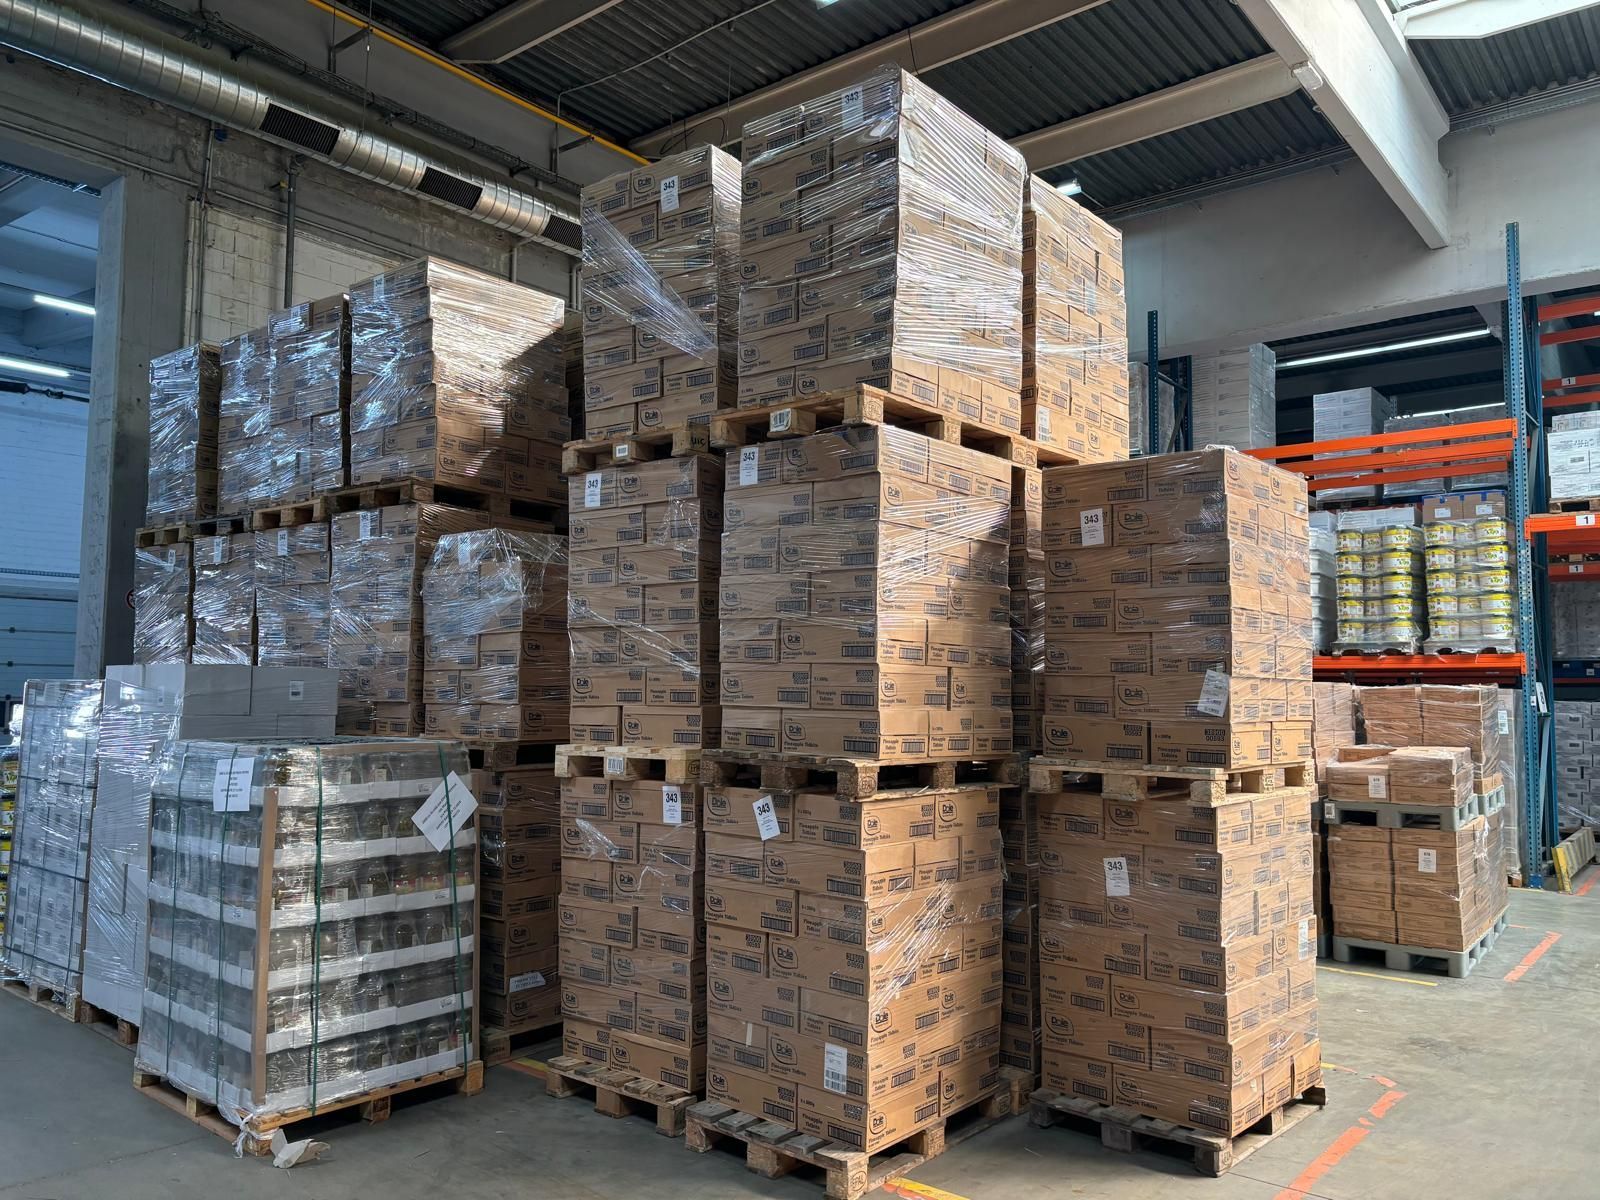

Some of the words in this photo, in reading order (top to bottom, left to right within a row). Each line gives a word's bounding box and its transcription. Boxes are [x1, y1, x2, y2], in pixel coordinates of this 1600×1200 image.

[844, 92, 859, 104] 343
[664, 180, 675, 191] 343
[802, 380, 815, 388] Dole
[645, 411, 658, 420] Dole
[743, 452, 755, 462] 343
[588, 480, 598, 488] 343
[888, 486, 900, 498] Dole
[1084, 514, 1099, 524] 343
[1125, 513, 1143, 522] Dole
[1584, 516, 1589, 524] 1
[1124, 606, 1139, 614] Dole
[1050, 651, 1064, 659] Dole
[577, 678, 588, 686] Dole
[727, 679, 739, 687] Dole
[884, 682, 894, 690] Dole
[1124, 689, 1143, 698] Dole
[788, 726, 802, 734] Dole
[1051, 729, 1068, 738] Dole
[666, 793, 678, 803] 343
[712, 796, 726, 806] Dole
[757, 803, 770, 816] 343
[942, 804, 954, 813] Dole
[1115, 808, 1134, 818] Dole
[867, 820, 878, 828] Dole
[567, 829, 580, 837] Dole
[770, 858, 784, 868] Dole
[1108, 862, 1122, 870] 343
[710, 896, 722, 906] Dole
[1114, 904, 1129, 913] Dole
[512, 928, 526, 938] Dole
[778, 949, 793, 960] Dole
[714, 982, 729, 992] Dole
[944, 994, 954, 1002] Dole
[1120, 993, 1134, 1002] Dole
[876, 1012, 888, 1024] Dole
[1052, 1016, 1068, 1026] Dole
[616, 1048, 626, 1056] Dole
[777, 1044, 792, 1056] Dole
[712, 1074, 724, 1086] Dole
[946, 1082, 954, 1092] Dole
[1121, 1081, 1136, 1090] Dole
[873, 1116, 884, 1126] Dole
